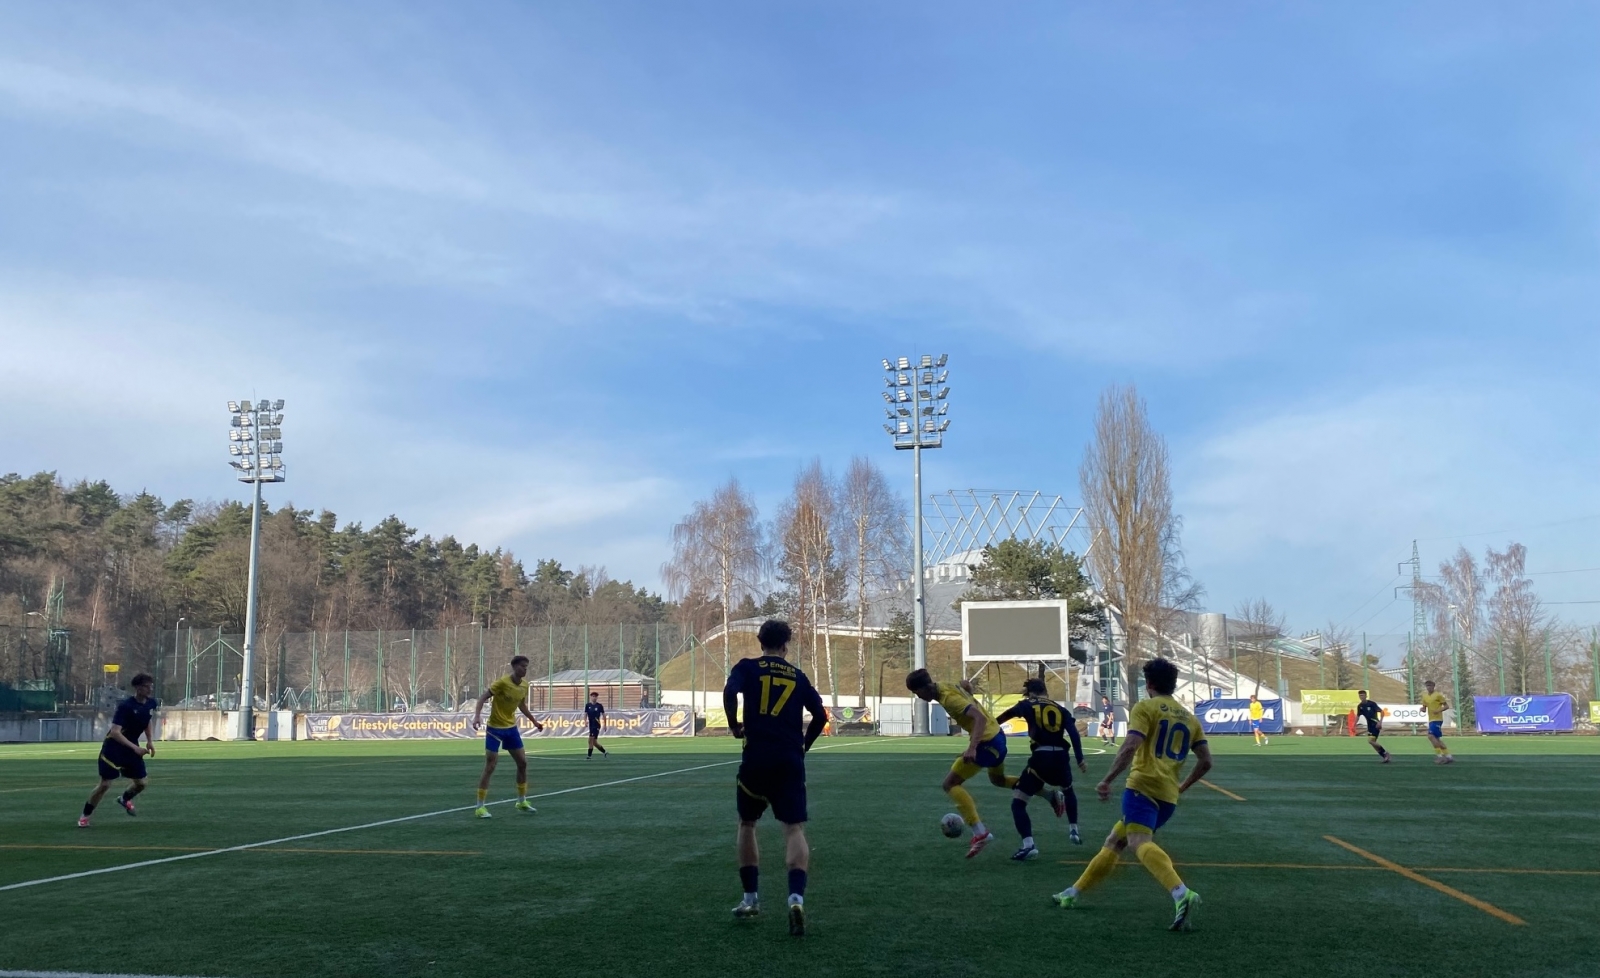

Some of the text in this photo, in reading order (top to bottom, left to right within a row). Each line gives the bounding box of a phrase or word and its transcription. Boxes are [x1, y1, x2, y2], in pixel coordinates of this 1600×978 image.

[759, 675, 796, 716] 17
[352, 717, 467, 733] Lifestyle-catering.pl
[1032, 704, 1062, 733] 10
[1393, 709, 1426, 719] opec
[1493, 715, 1550, 724] TRICARGO
[1155, 719, 1191, 762] 10
